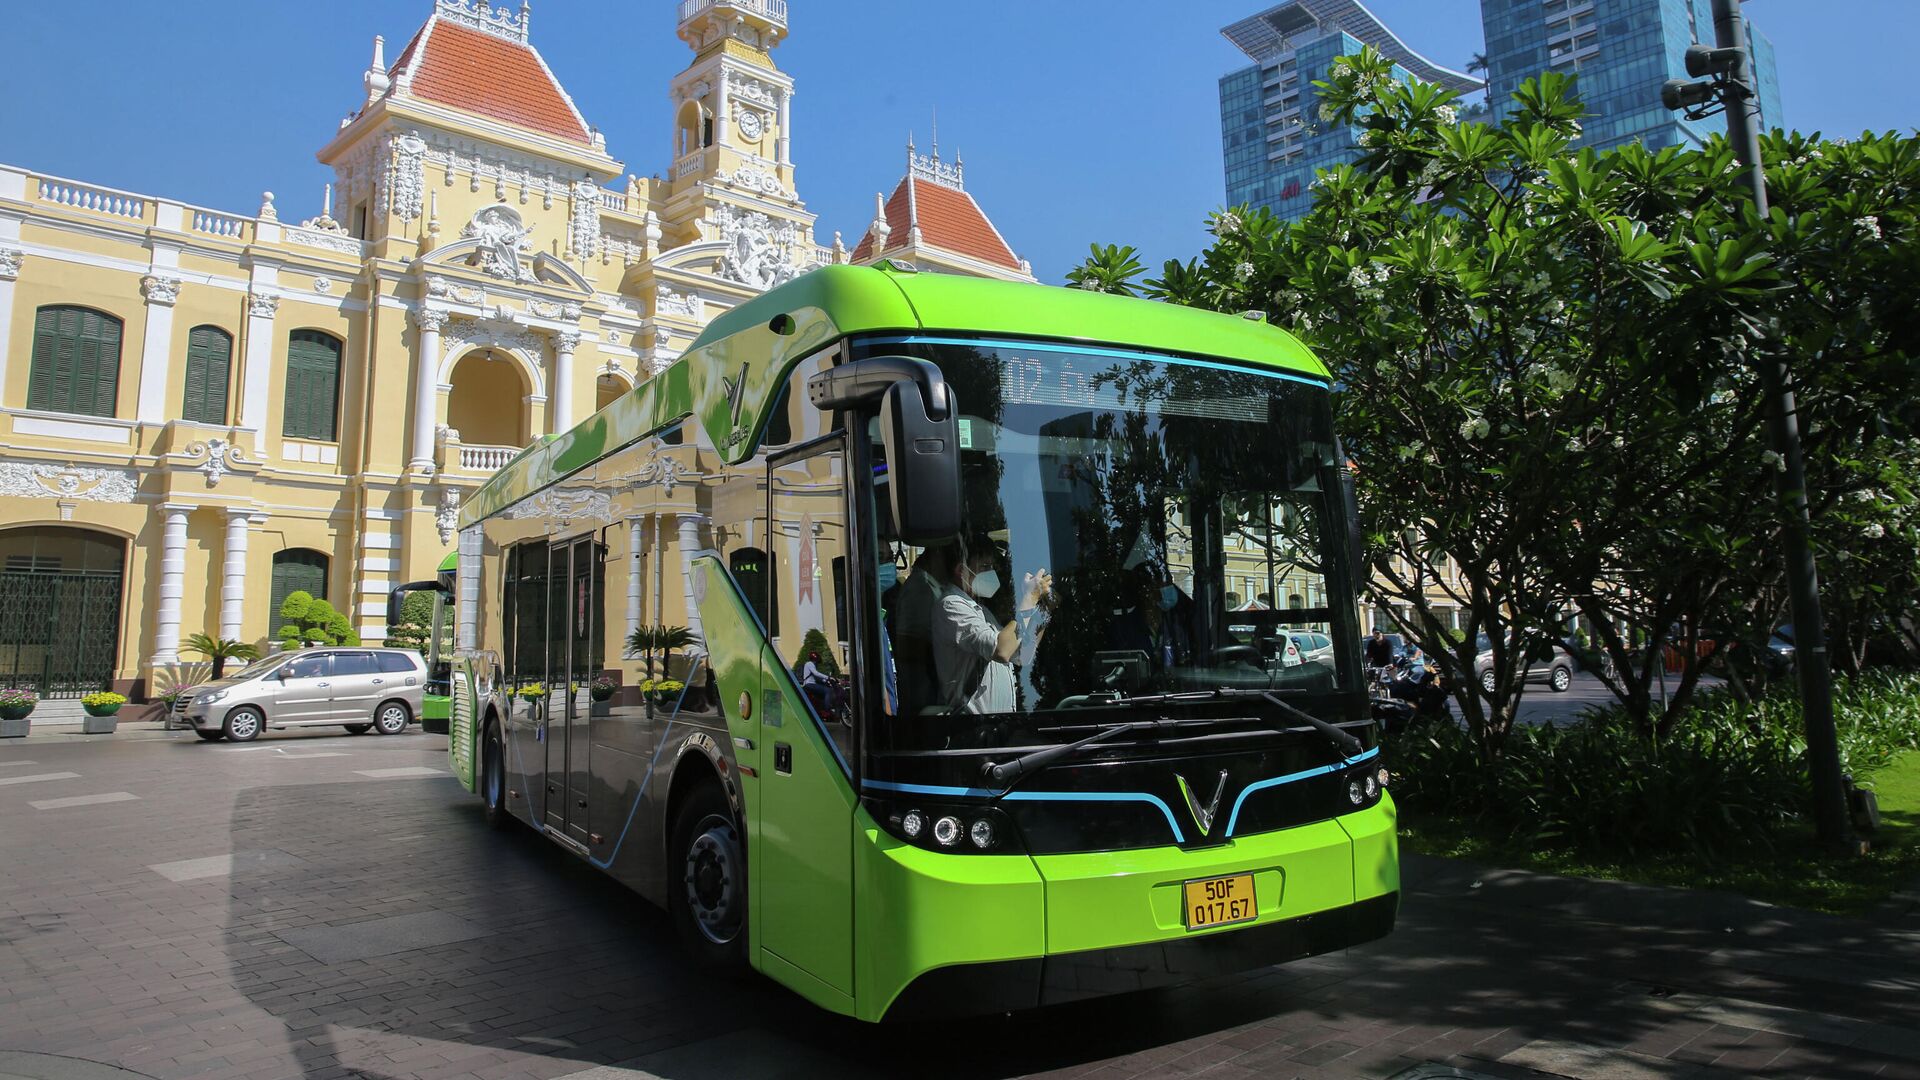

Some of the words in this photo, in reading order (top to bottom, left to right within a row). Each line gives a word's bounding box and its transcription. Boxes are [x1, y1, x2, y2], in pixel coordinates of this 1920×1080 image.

[1008, 356, 1042, 404] 02
[1205, 879, 1235, 901] 50F
[1195, 898, 1249, 924] 017.67
